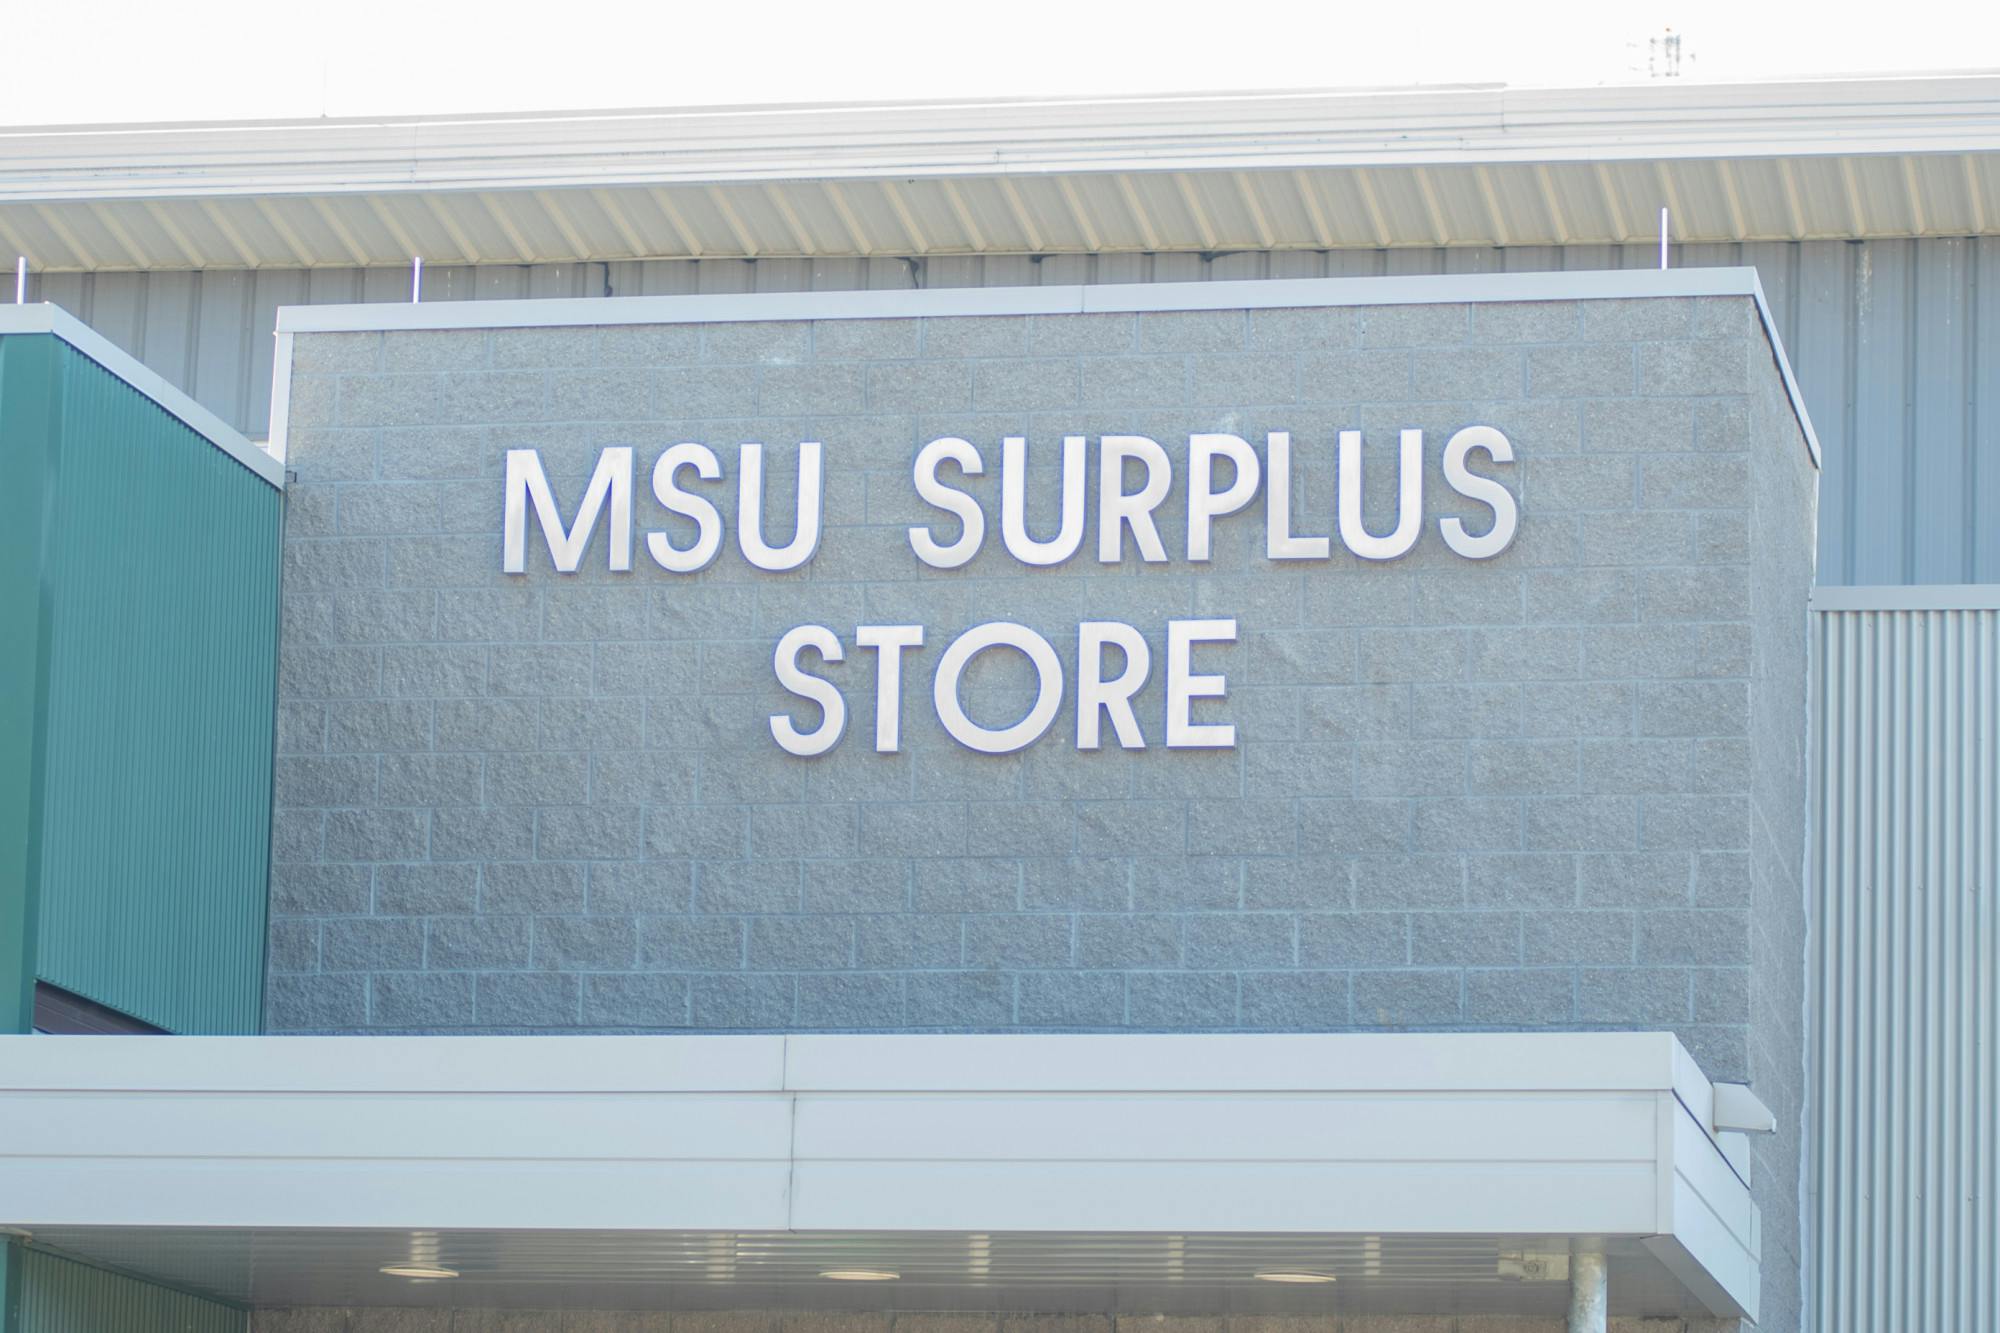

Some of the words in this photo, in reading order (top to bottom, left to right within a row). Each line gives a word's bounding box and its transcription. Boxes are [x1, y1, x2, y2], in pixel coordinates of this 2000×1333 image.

[503, 441, 823, 574] MSU
[907, 424, 1519, 569] SURPLUS
[769, 618, 1238, 757] STORE
